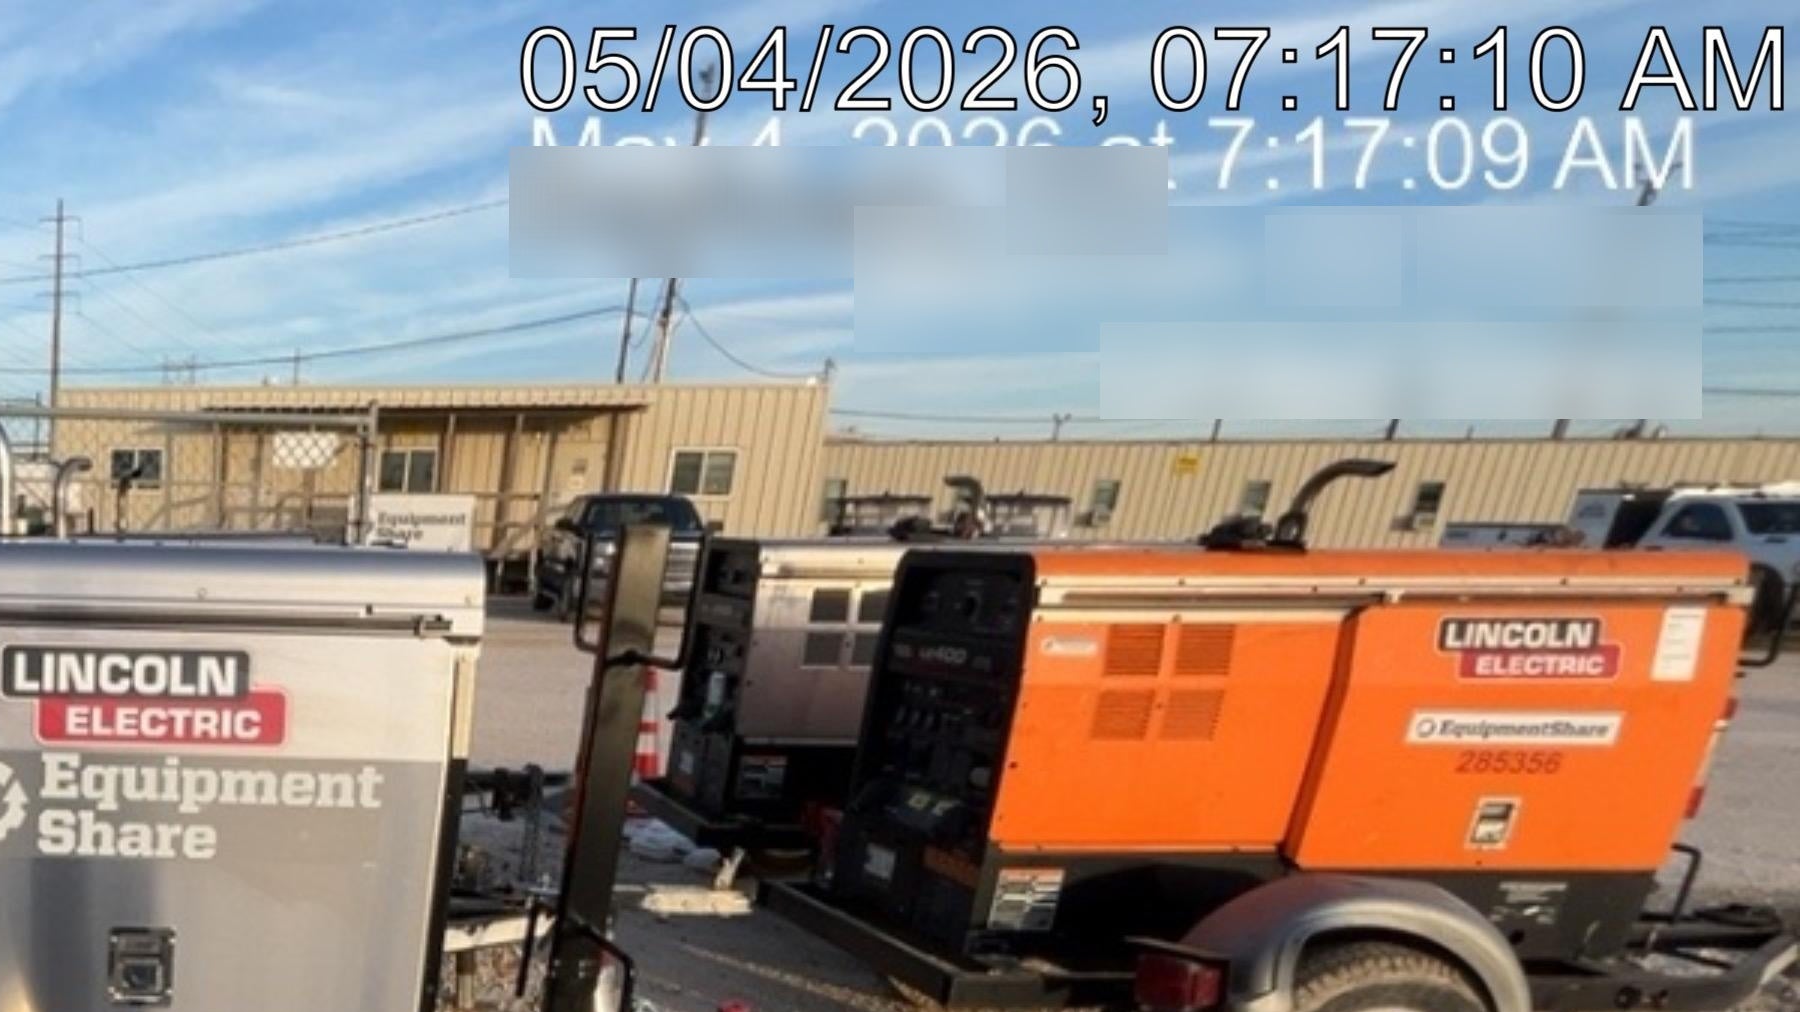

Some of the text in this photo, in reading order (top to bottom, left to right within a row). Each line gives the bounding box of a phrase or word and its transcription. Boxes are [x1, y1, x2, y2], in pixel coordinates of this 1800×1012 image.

[1445, 622, 1593, 648] LINCOLN
[12, 651, 239, 697] LINCOLN
[1476, 654, 1604, 675] ELECTRIC
[64, 705, 263, 741] ELECTRIC
[1439, 719, 1608, 739] EquipmentShare
[1456, 752, 1561, 774] 285356
[38, 752, 385, 812] Equipment
[37, 808, 218, 860] Share
